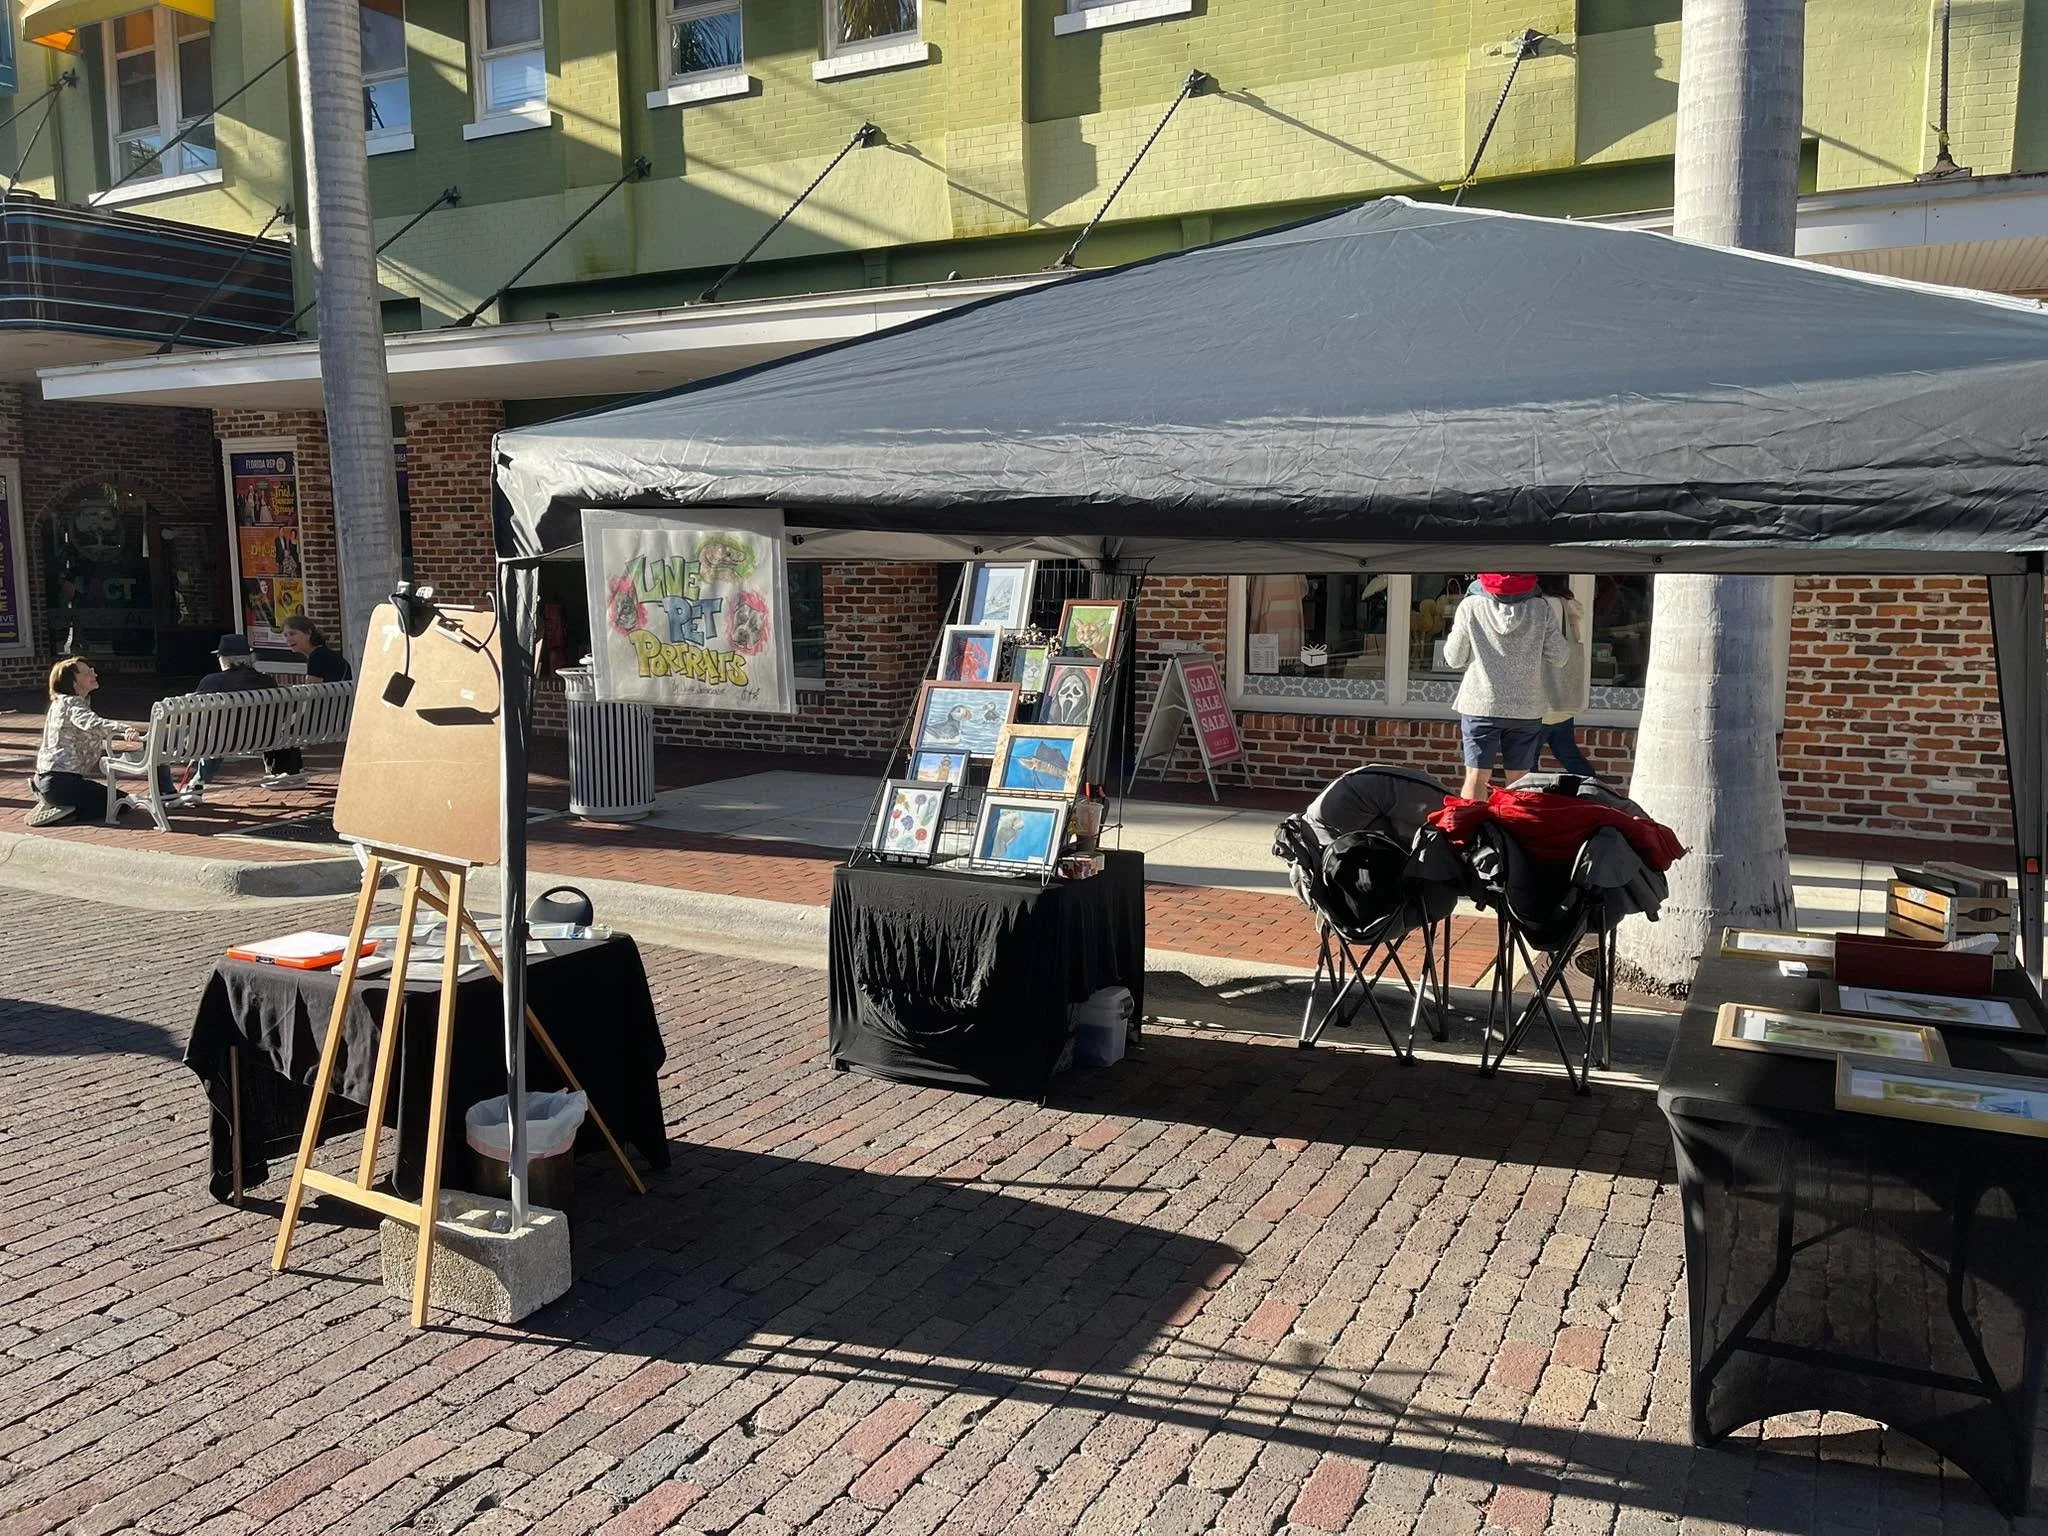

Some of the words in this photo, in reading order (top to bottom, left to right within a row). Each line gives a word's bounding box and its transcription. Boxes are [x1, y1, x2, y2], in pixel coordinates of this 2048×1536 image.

[246, 459, 266, 469] FLORIDA
[266, 459, 276, 469] REP
[625, 554, 701, 604] LIVE
[658, 596, 724, 646] PET
[627, 628, 749, 687] PORTRAITS
[1190, 676, 1215, 693] SALE
[1196, 696, 1221, 712] SALE
[1202, 716, 1228, 733] SALE
